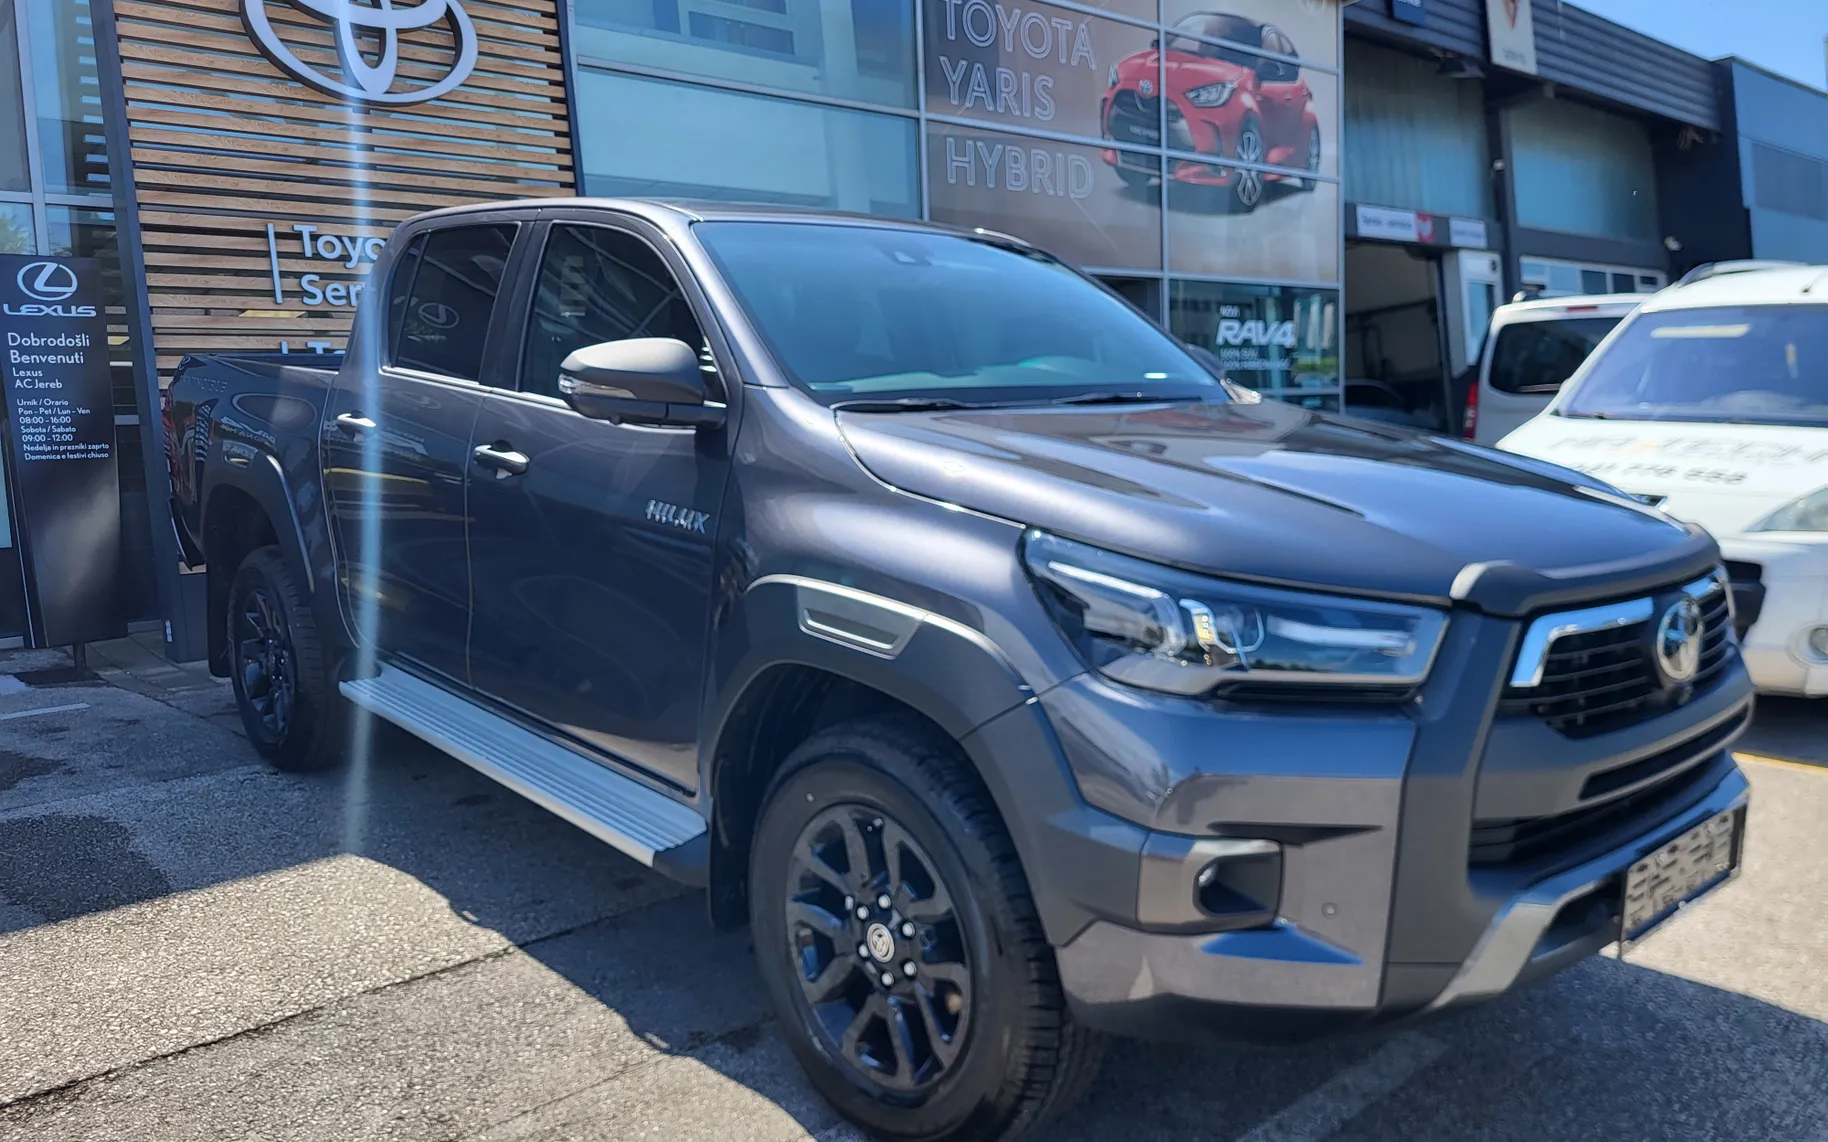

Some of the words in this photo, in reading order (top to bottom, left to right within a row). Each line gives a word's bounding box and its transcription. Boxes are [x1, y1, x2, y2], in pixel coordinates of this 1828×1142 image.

[944, 0, 1097, 70] TOYOTA
[939, 56, 1056, 121] YARIS
[946, 137, 1095, 199] HYBRID
[300, 274, 365, 307] Ser
[3, 303, 97, 317] LEXUS
[8, 332, 90, 347] Dobrodošli
[1215, 318, 1296, 349] RAV4
[10, 349, 84, 364] Benvenuti
[12, 366, 43, 377] Lexus
[15, 379, 33, 389] AC
[34, 378, 63, 389] Jereb
[17, 398, 38, 406] Urnik
[43, 398, 69, 406] Orario
[18, 407, 33, 415] Pon
[39, 407, 52, 415] Pet
[57, 407, 71, 415] Lun
[77, 406, 91, 414] Ven
[19, 416, 44, 424] 08:00
[50, 416, 71, 424] 16:00
[20, 425, 47, 434] Sobota
[51, 425, 77, 433] Sabato
[21, 434, 46, 442] 09:00
[52, 433, 74, 442] 12:00
[23, 444, 51, 453] Nedelja
[59, 442, 87, 452] prazniki
[88, 442, 110, 451] zaprto
[24, 453, 61, 461] Domenica
[66, 451, 87, 459] festivi
[645, 499, 711, 534] HILUX
